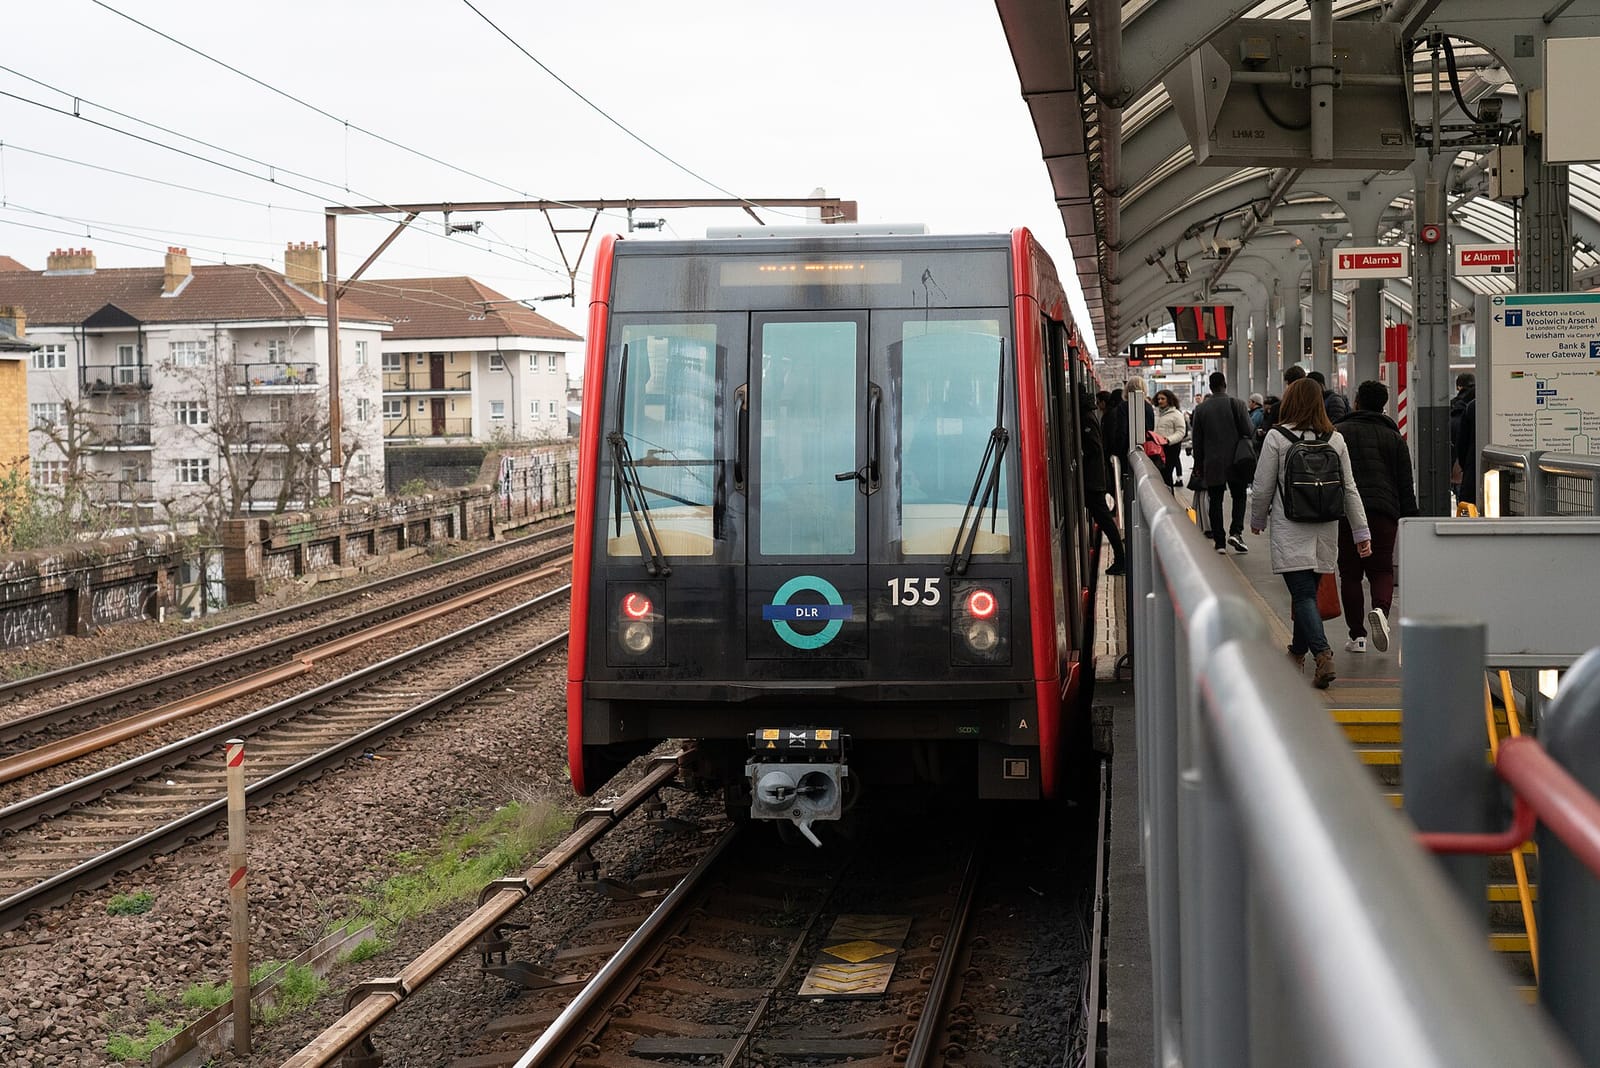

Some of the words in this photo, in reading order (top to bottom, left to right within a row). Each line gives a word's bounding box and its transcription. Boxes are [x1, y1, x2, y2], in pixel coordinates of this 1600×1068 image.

[1232, 129, 1253, 139] LHM
[1254, 129, 1266, 139] 32
[1362, 255, 1390, 265] Alarm
[1473, 252, 1500, 262] Alarm
[1526, 309, 1558, 317] Beckton
[1526, 317, 1565, 325] Woolwich
[1567, 316, 1597, 324] Arsenal
[1556, 324, 1568, 332] City
[1526, 331, 1565, 339] Lewisham
[1576, 332, 1595, 340] Canary
[1559, 342, 1578, 350] Bank
[1526, 351, 1550, 359] Tower
[1551, 351, 1586, 360] Gateway
[887, 577, 941, 606] 155
[796, 607, 818, 617] DLR
[1018, 718, 1028, 729] A
